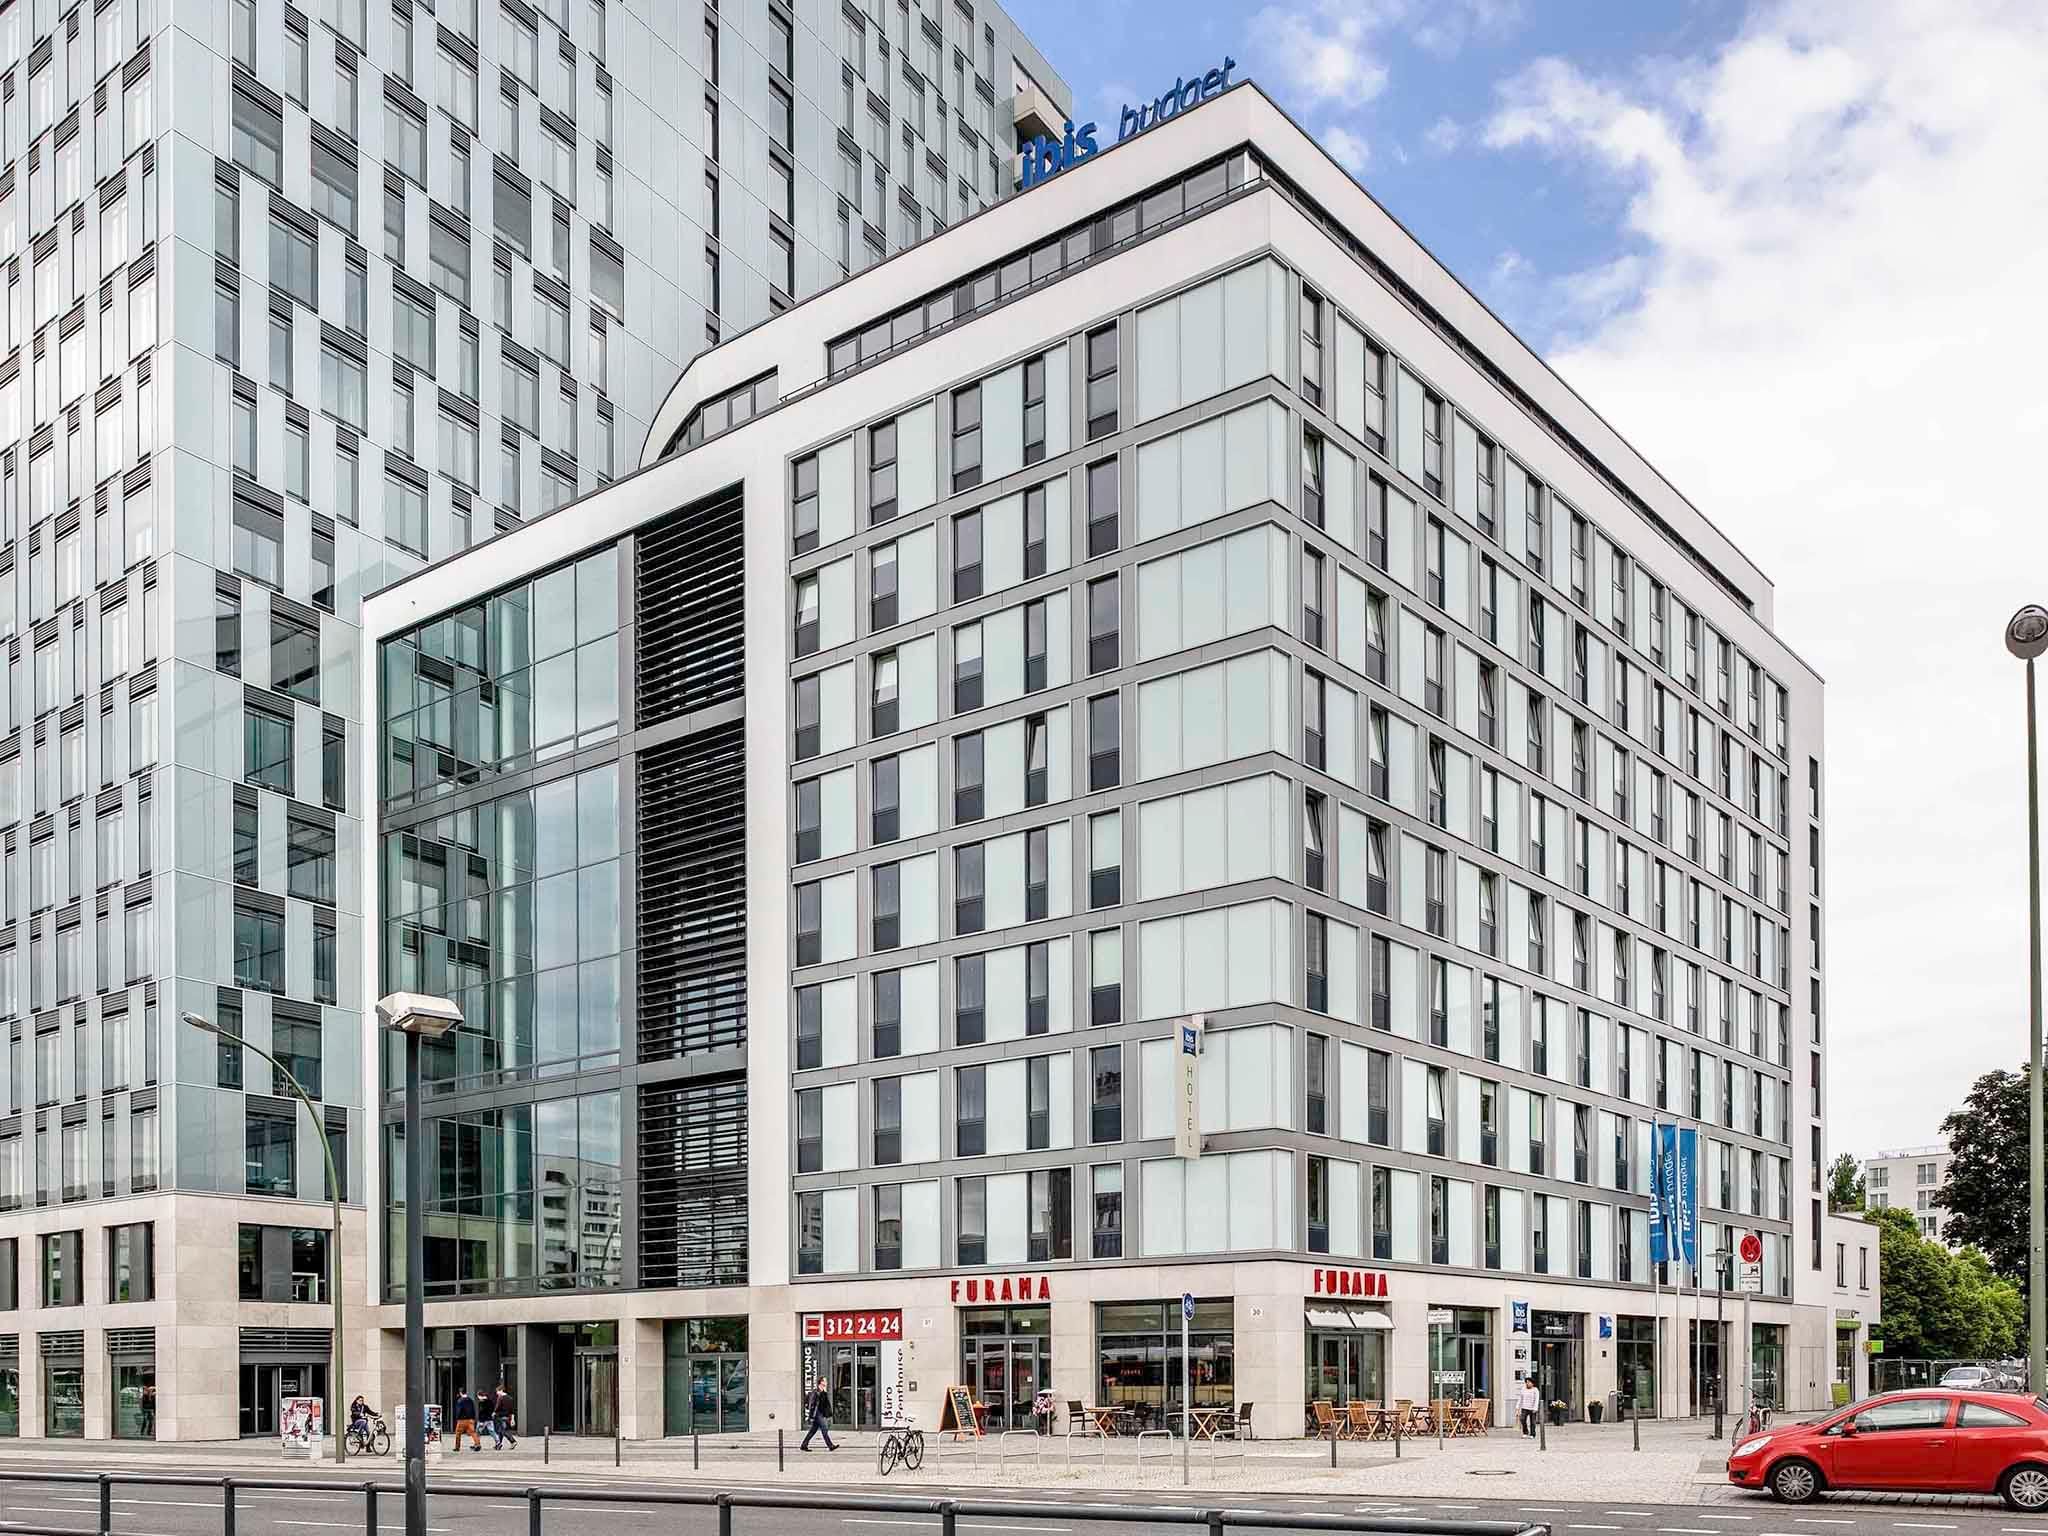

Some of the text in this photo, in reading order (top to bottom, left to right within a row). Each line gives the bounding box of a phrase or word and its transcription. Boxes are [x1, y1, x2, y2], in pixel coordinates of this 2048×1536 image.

[1023, 55, 1236, 191] ibis budget
[951, 1276, 1051, 1302] FURAMA
[1314, 1268, 1388, 1297] FURAMA
[827, 1316, 899, 1335] 312 24 24
